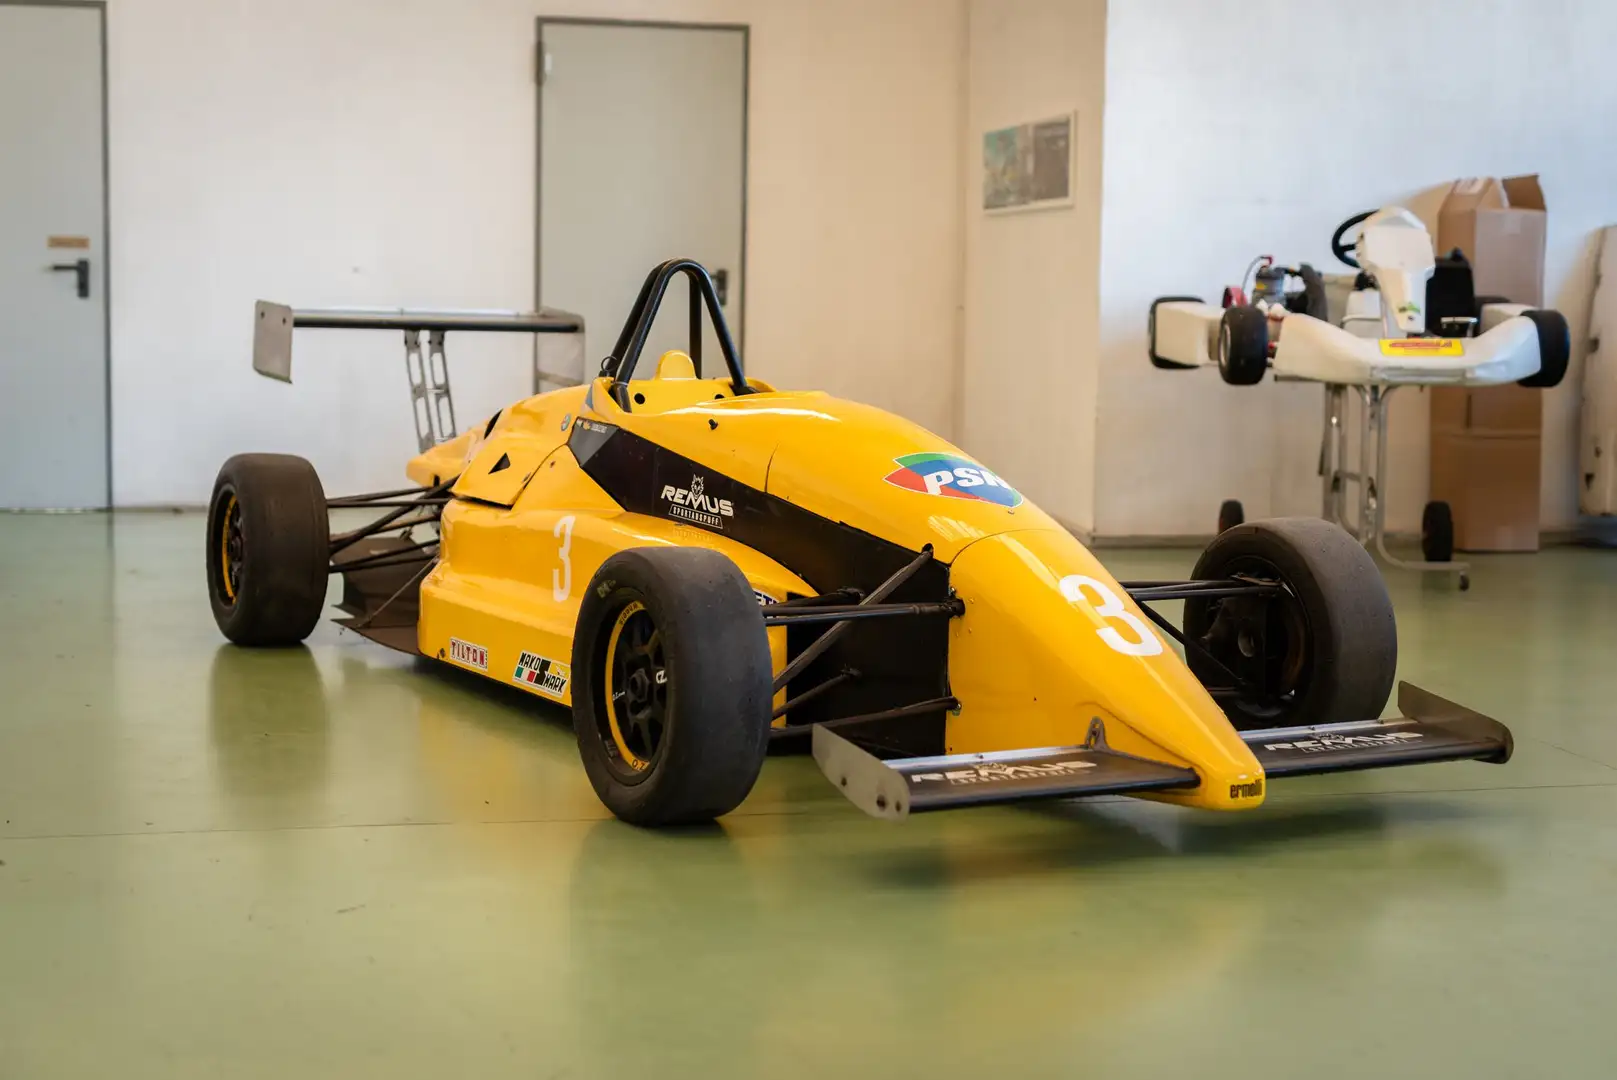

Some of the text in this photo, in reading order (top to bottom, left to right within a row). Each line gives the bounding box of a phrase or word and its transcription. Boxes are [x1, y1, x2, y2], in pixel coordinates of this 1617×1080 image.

[660, 485, 733, 516] REMUS
[672, 506, 719, 525] SPORTAUSPUFF
[552, 515, 576, 602] 3
[1059, 574, 1163, 656] 3
[451, 641, 485, 665] TILTON
